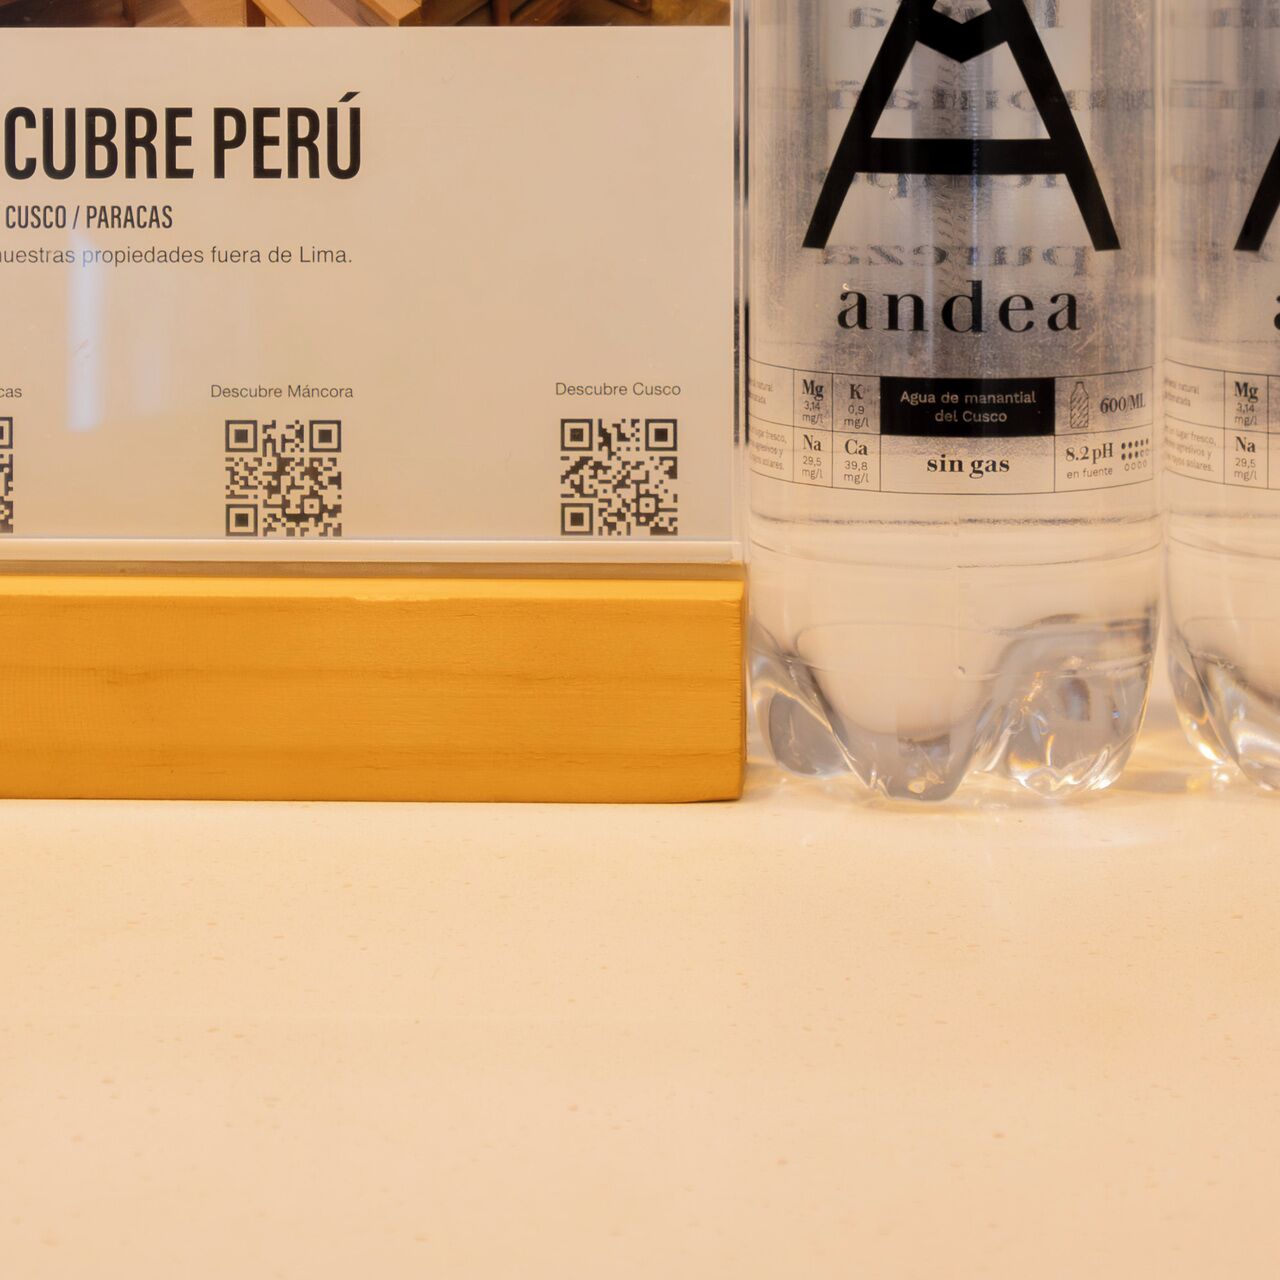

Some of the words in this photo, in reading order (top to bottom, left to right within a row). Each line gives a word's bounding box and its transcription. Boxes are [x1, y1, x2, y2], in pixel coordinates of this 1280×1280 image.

[213, 91, 361, 180] PERÚ
[5, 205, 67, 230] CUSCO
[86, 205, 173, 230] PARACAS
[82, 245, 204, 268] propiedades
[210, 245, 261, 264] fuera
[268, 245, 293, 264] de
[299, 245, 353, 264] Lima.
[837, 280, 1081, 333] andea
[210, 384, 282, 399] Descubre
[288, 384, 354, 399] Máncora
[555, 382, 628, 396] Descubre
[632, 382, 681, 396] Cusco
[802, 379, 824, 401] Mg
[849, 383, 863, 400] K
[1234, 381, 1258, 403] Mg
[900, 391, 936, 406] Agua
[941, 391, 959, 404] de
[965, 390, 1036, 404] manantial
[804, 400, 821, 412] 3,14
[848, 404, 864, 416] 0,9
[1236, 403, 1255, 414] 3,14
[802, 413, 824, 425] mg/l
[844, 417, 869, 429] mg/l
[935, 409, 956, 422] del
[962, 410, 1007, 423] Cusco
[1234, 416, 1257, 427] mg/l
[803, 434, 822, 451] Na
[844, 438, 868, 456] Ca
[1235, 436, 1256, 453] Na
[803, 455, 822, 467] 29,5
[844, 460, 868, 471] 39,8
[927, 454, 964, 472] sin
[969, 458, 1010, 479] gas
[1235, 457, 1256, 469] 29,5
[802, 469, 823, 480] mg/l
[844, 473, 869, 485] mg/l
[1067, 471, 1079, 479] en
[1083, 467, 1113, 478] fuente
[1234, 470, 1257, 481] mg/l
